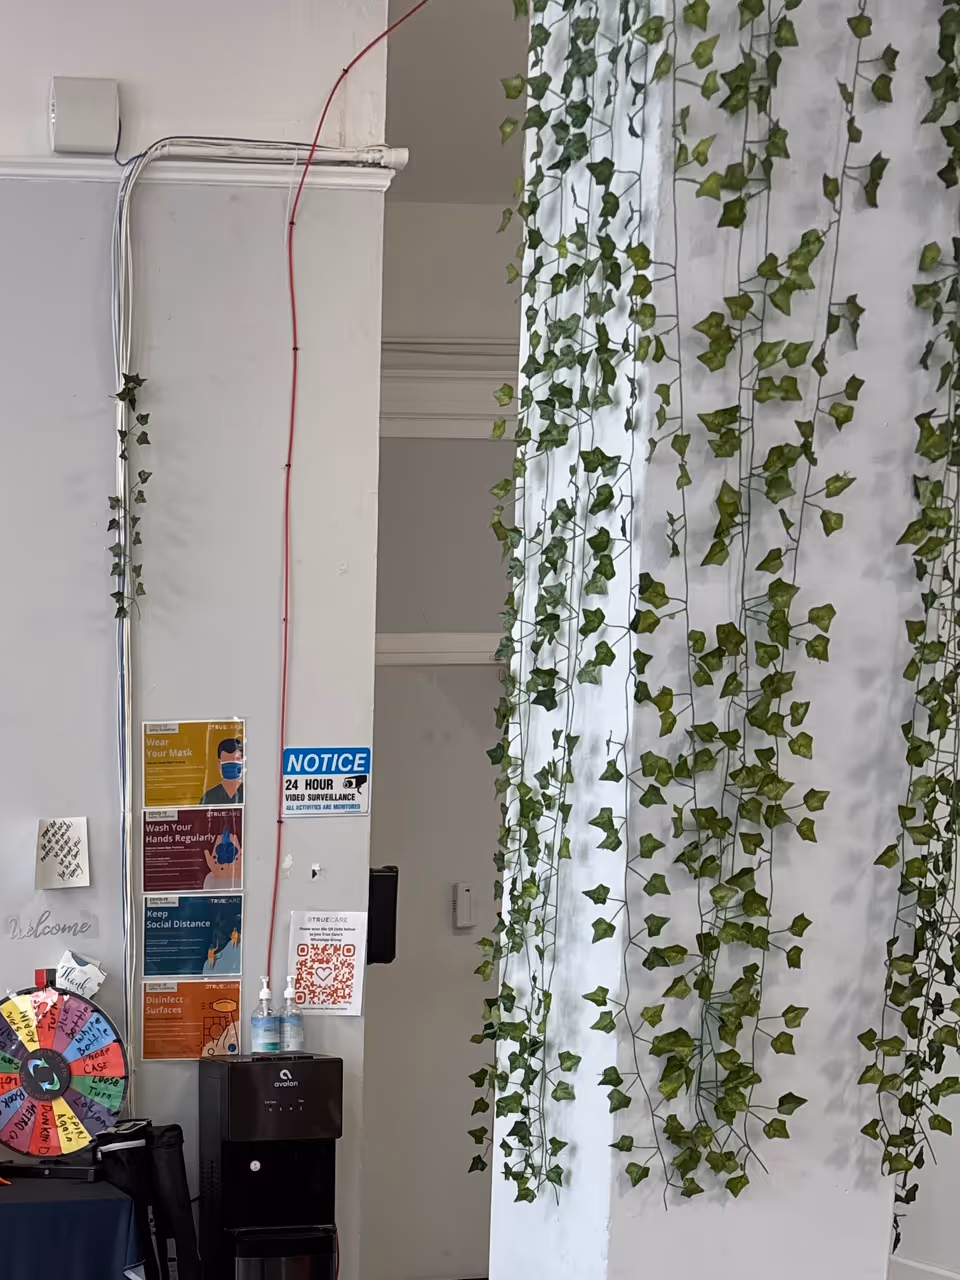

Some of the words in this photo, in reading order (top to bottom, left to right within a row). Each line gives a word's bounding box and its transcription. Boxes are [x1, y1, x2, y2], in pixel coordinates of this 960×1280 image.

[146, 738, 169, 746] Wear
[146, 749, 167, 758] Your
[169, 748, 193, 757] Mask
[287, 753, 367, 772] NOTICE
[285, 779, 299, 790] 24
[304, 779, 333, 790] HOUR
[285, 793, 305, 801] VIDEO
[307, 793, 355, 801] SURVEILLANCE
[145, 824, 169, 832] Wash
[145, 835, 173, 843] Hands
[175, 833, 216, 843] Regularly
[147, 910, 168, 919] Keep
[8, 910, 91, 940] Welcome
[146, 920, 171, 928] Social
[173, 919, 211, 928] Distance
[60, 965, 90, 995] Thank
[146, 996, 184, 1004] Disinfect
[145, 1006, 182, 1014] Surfaces
